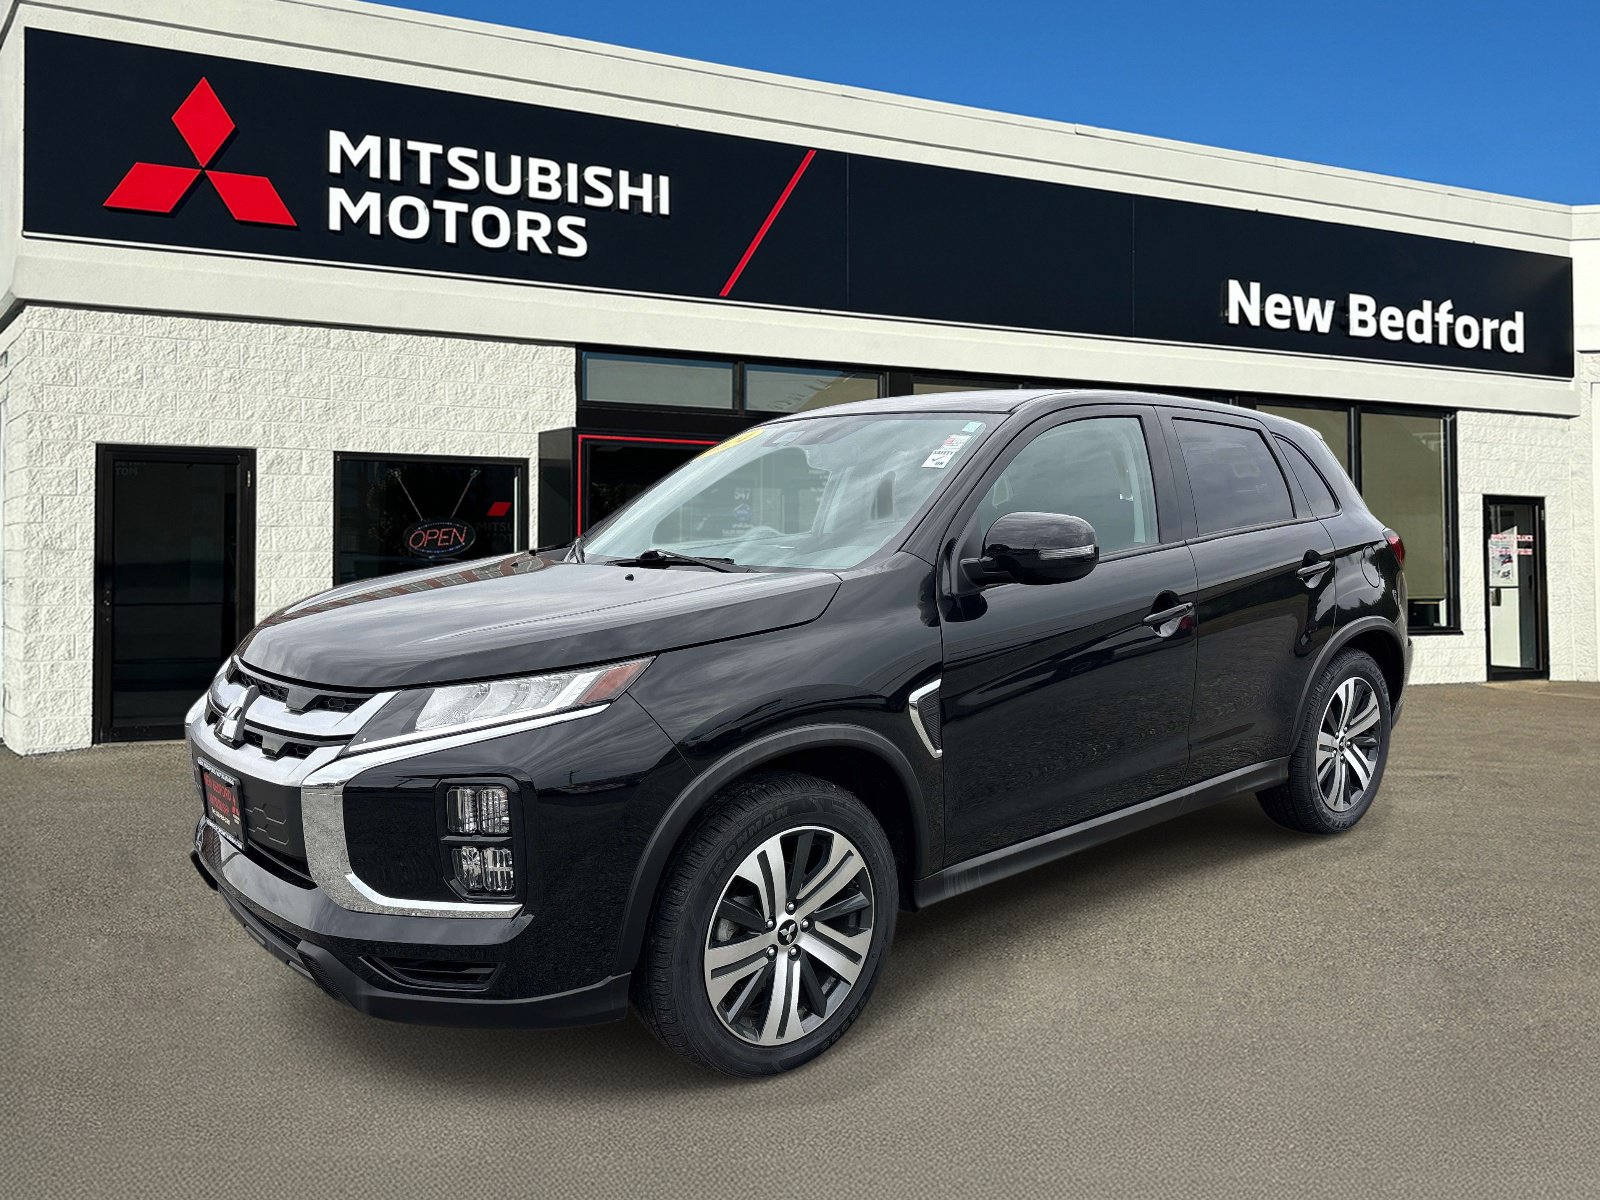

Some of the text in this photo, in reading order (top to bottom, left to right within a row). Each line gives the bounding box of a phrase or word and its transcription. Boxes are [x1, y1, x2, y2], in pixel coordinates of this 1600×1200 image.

[328, 129, 670, 216] MITSUBISHI
[328, 186, 589, 258] MOTORS
[1227, 278, 1525, 354] New Bedford
[409, 527, 467, 549] OPEN
[708, 806, 789, 885] IRONMAN
